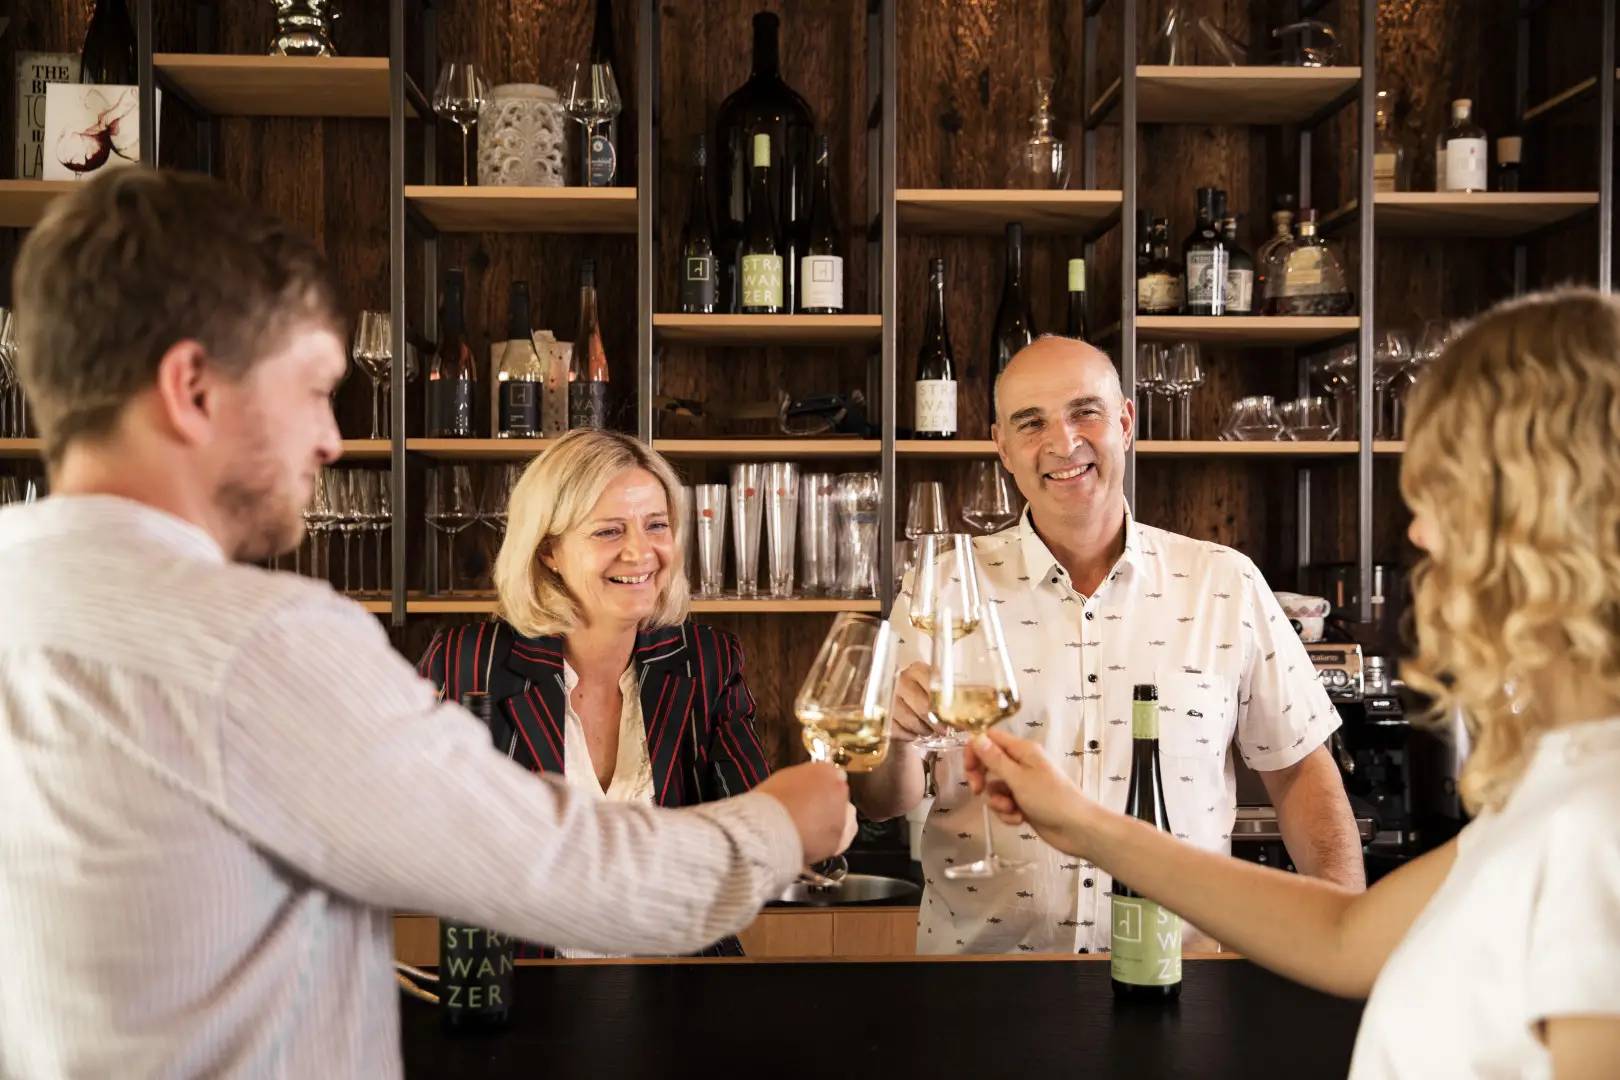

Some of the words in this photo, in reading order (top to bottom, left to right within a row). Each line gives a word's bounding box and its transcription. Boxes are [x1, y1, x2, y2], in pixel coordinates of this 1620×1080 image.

[31, 65, 70, 80] THE
[743, 258, 781, 272] STRA
[743, 274, 781, 288] WAN
[743, 290, 774, 303] ZER
[919, 415, 950, 428] ZER
[447, 951, 513, 978] WAN
[446, 985, 503, 1008] ZER
